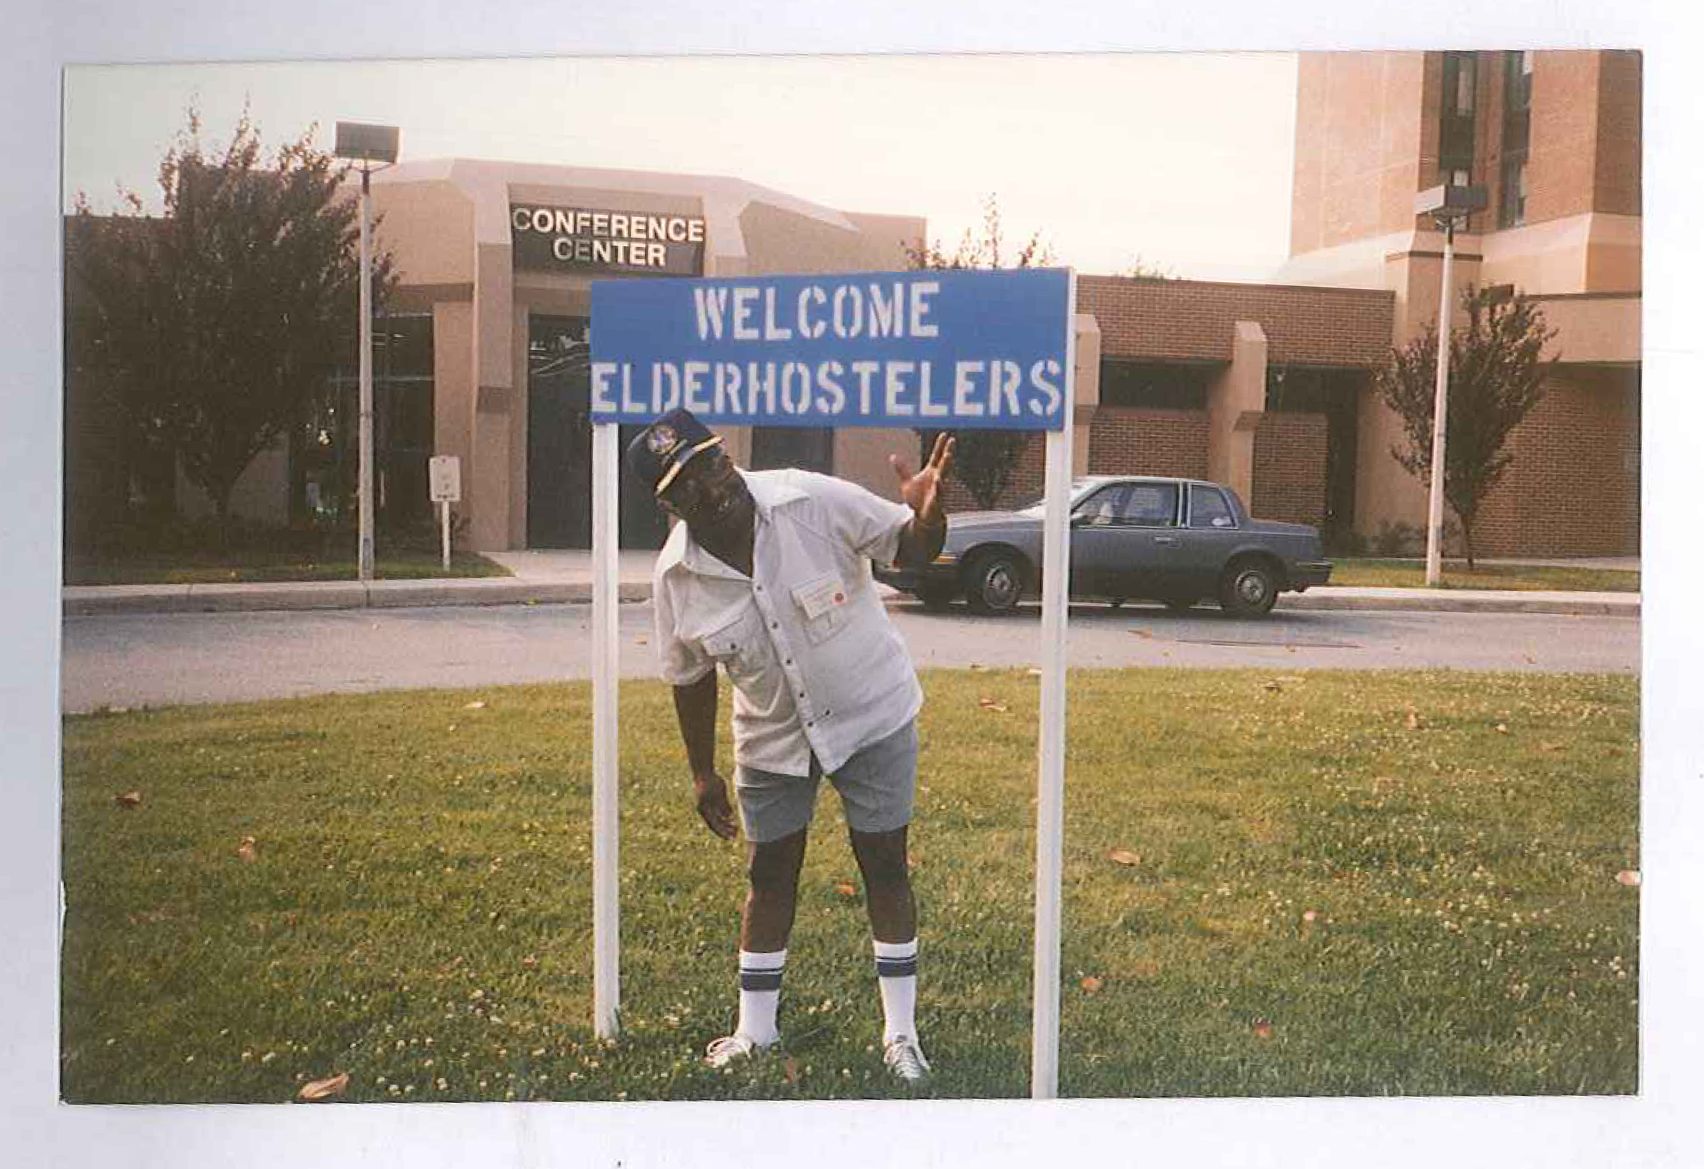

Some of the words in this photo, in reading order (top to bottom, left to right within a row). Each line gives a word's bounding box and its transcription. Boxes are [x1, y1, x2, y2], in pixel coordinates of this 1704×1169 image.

[512, 207, 704, 241] CONFERENCE
[553, 237, 666, 266] CENTER
[694, 282, 939, 340] WELCOME
[591, 361, 1062, 415] ELDERHOSTELERS
